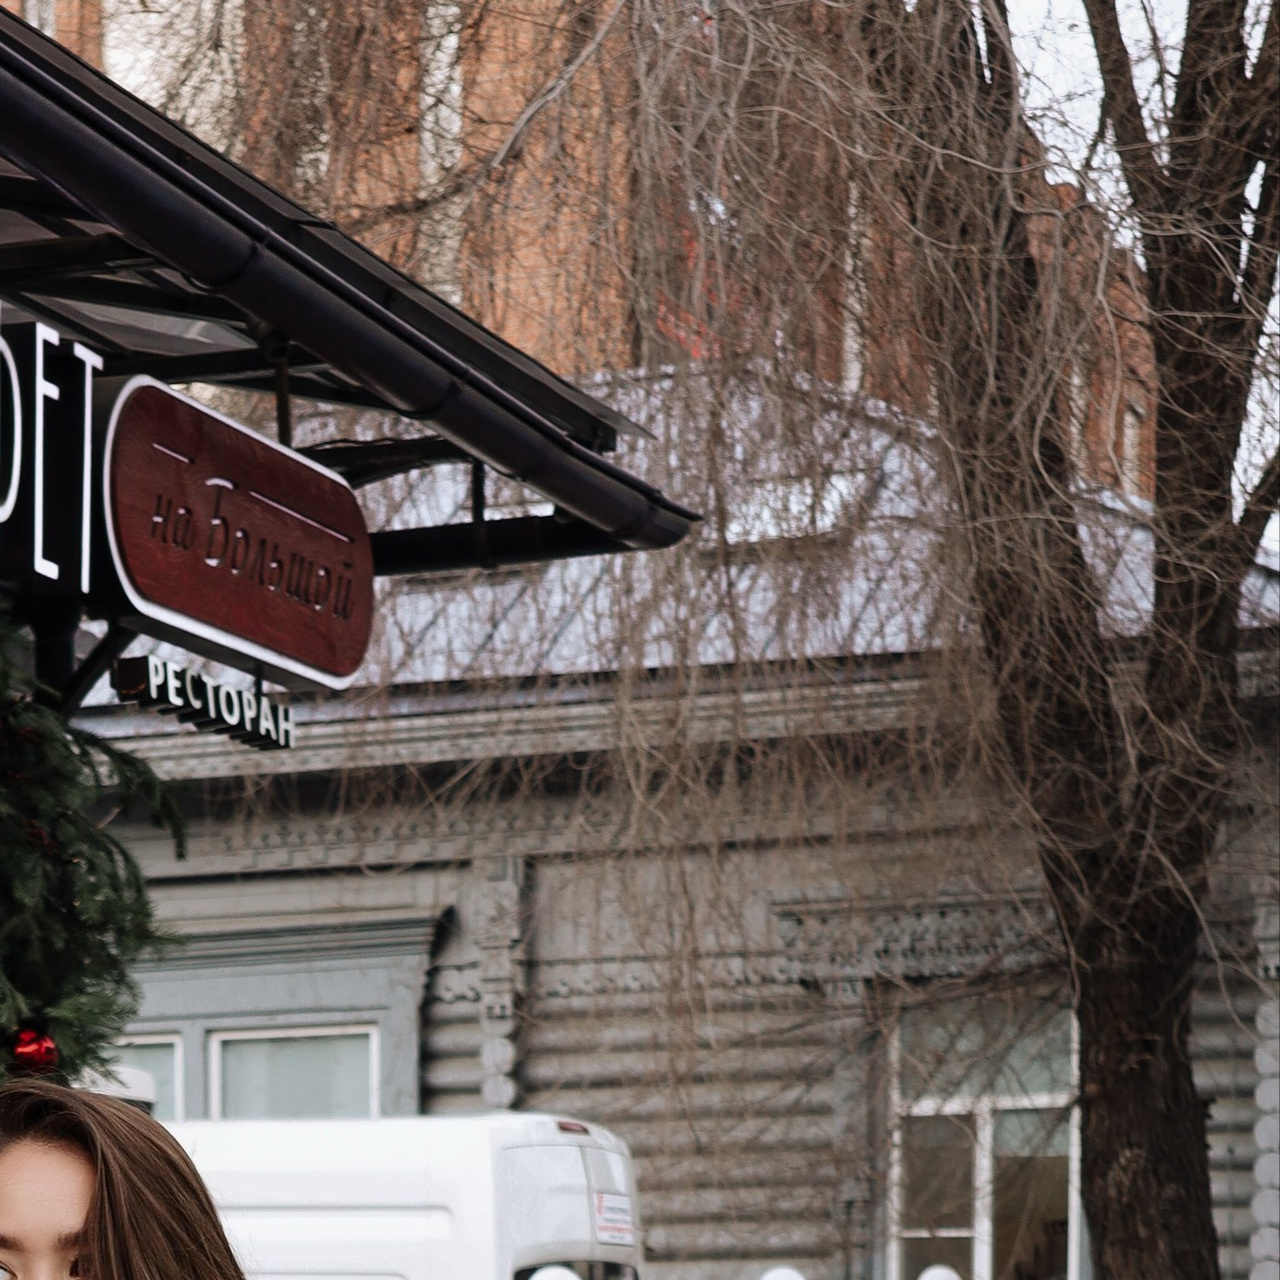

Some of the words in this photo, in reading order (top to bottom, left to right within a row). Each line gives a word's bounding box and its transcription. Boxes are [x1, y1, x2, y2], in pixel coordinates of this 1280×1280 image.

[150, 494, 193, 552] на
[204, 477, 354, 621] Большой
[148, 655, 295, 749] РЕСТОРАН
